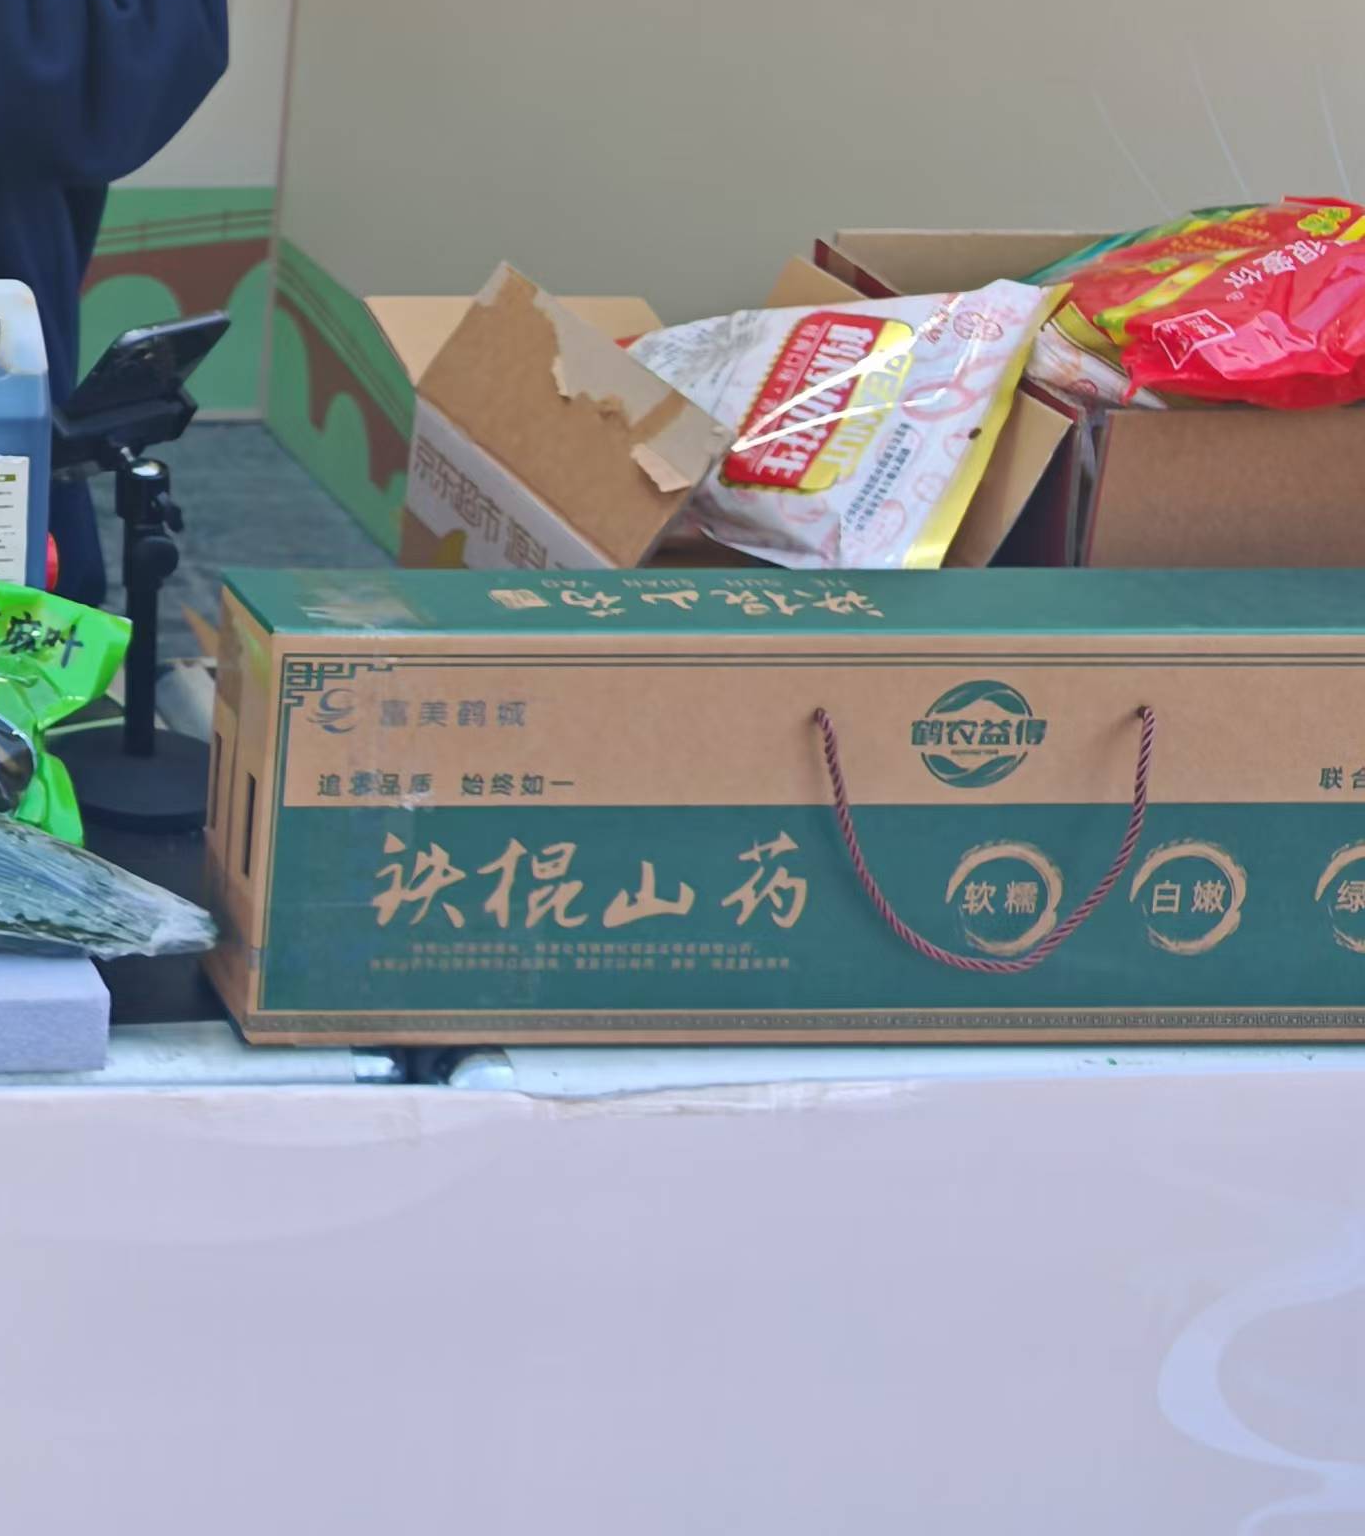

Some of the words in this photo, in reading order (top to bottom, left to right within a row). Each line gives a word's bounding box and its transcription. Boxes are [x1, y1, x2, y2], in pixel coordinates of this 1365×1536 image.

[461, 773, 575, 797] 始终如一
[372, 831, 807, 929] 铁棍山药
[962, 880, 1039, 915] 软糯
[1151, 879, 1227, 914] 白嫩
